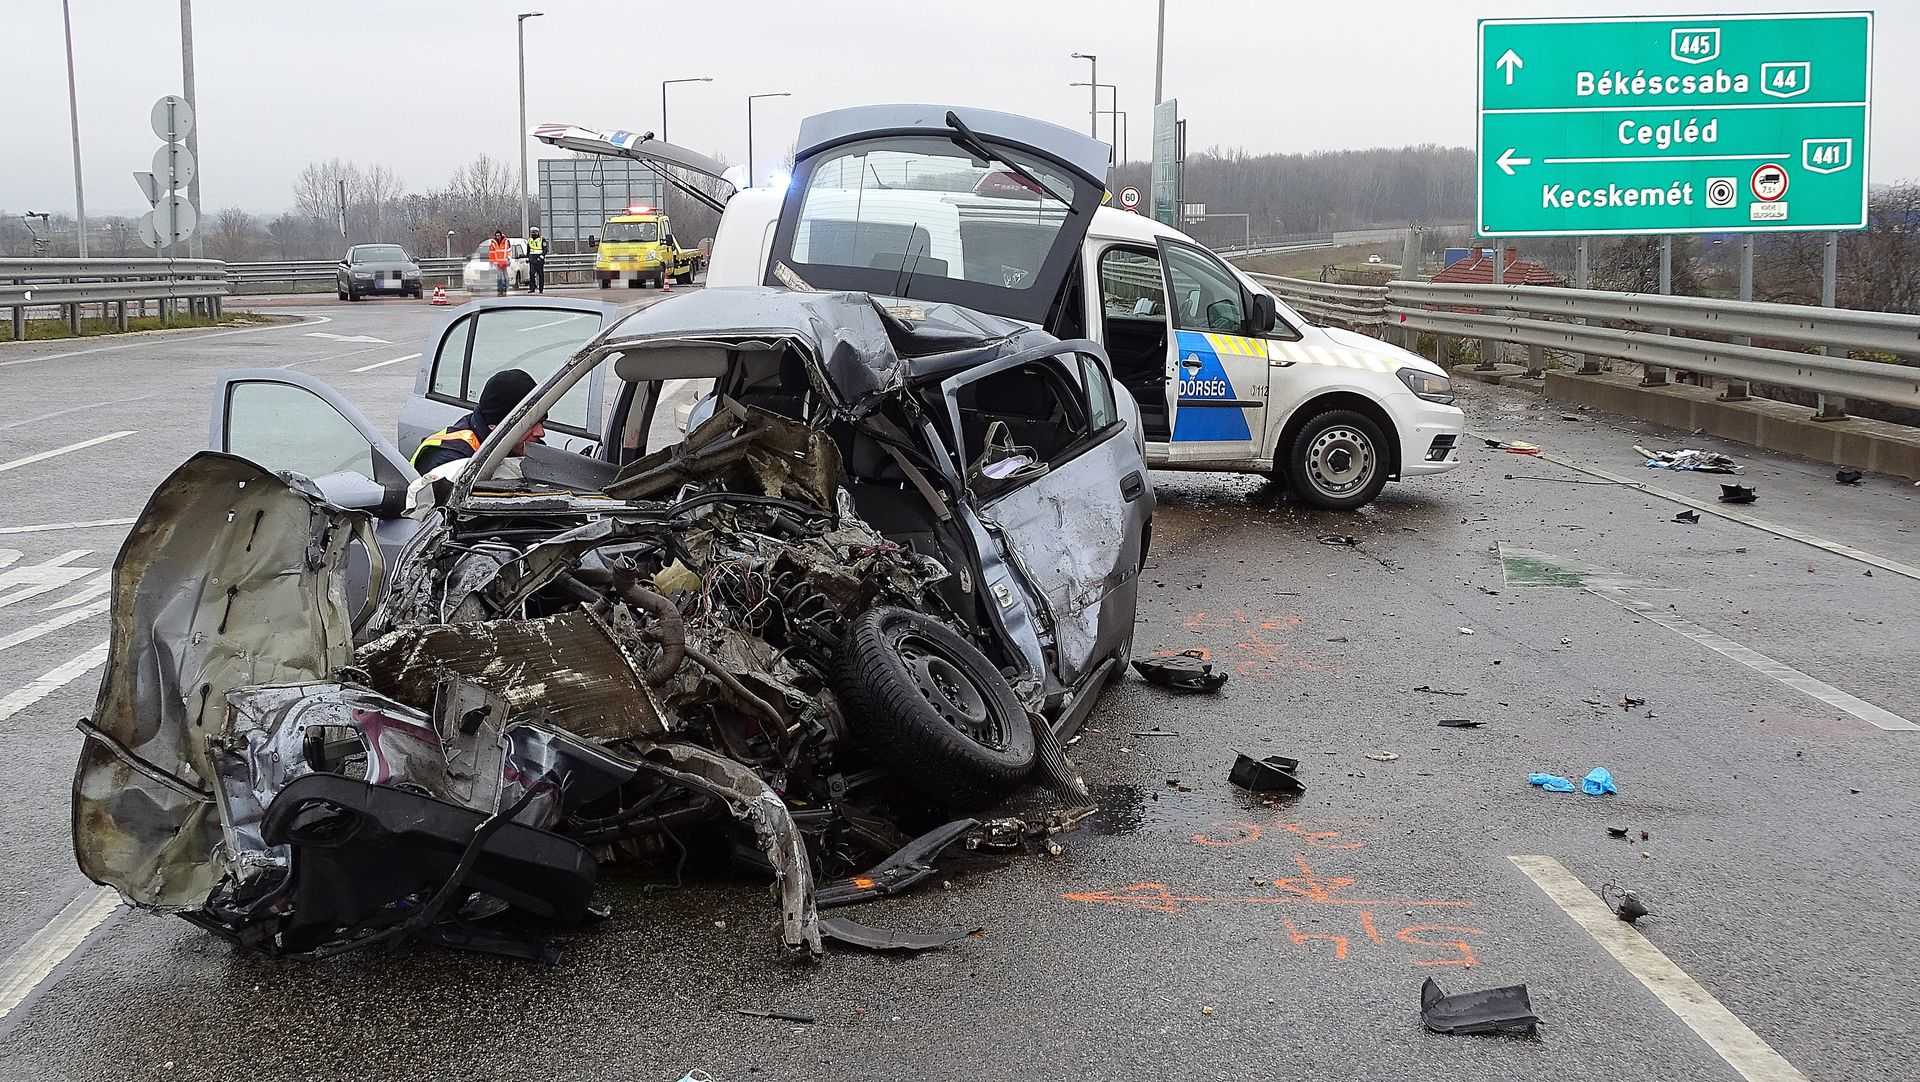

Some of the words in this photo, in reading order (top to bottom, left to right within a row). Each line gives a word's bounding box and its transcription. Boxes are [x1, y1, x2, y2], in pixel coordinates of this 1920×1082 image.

[1679, 35, 1711, 54] 445
[1576, 69, 1749, 97] Békéscsaba
[1771, 69, 1798, 89] 44
[1617, 118, 1718, 149] Cegléd
[1812, 144, 1841, 164] 441
[1125, 193, 1136, 202] 60
[1542, 179, 1694, 209] Kecskemét
[1178, 376, 1226, 397] DŐRSÉG
